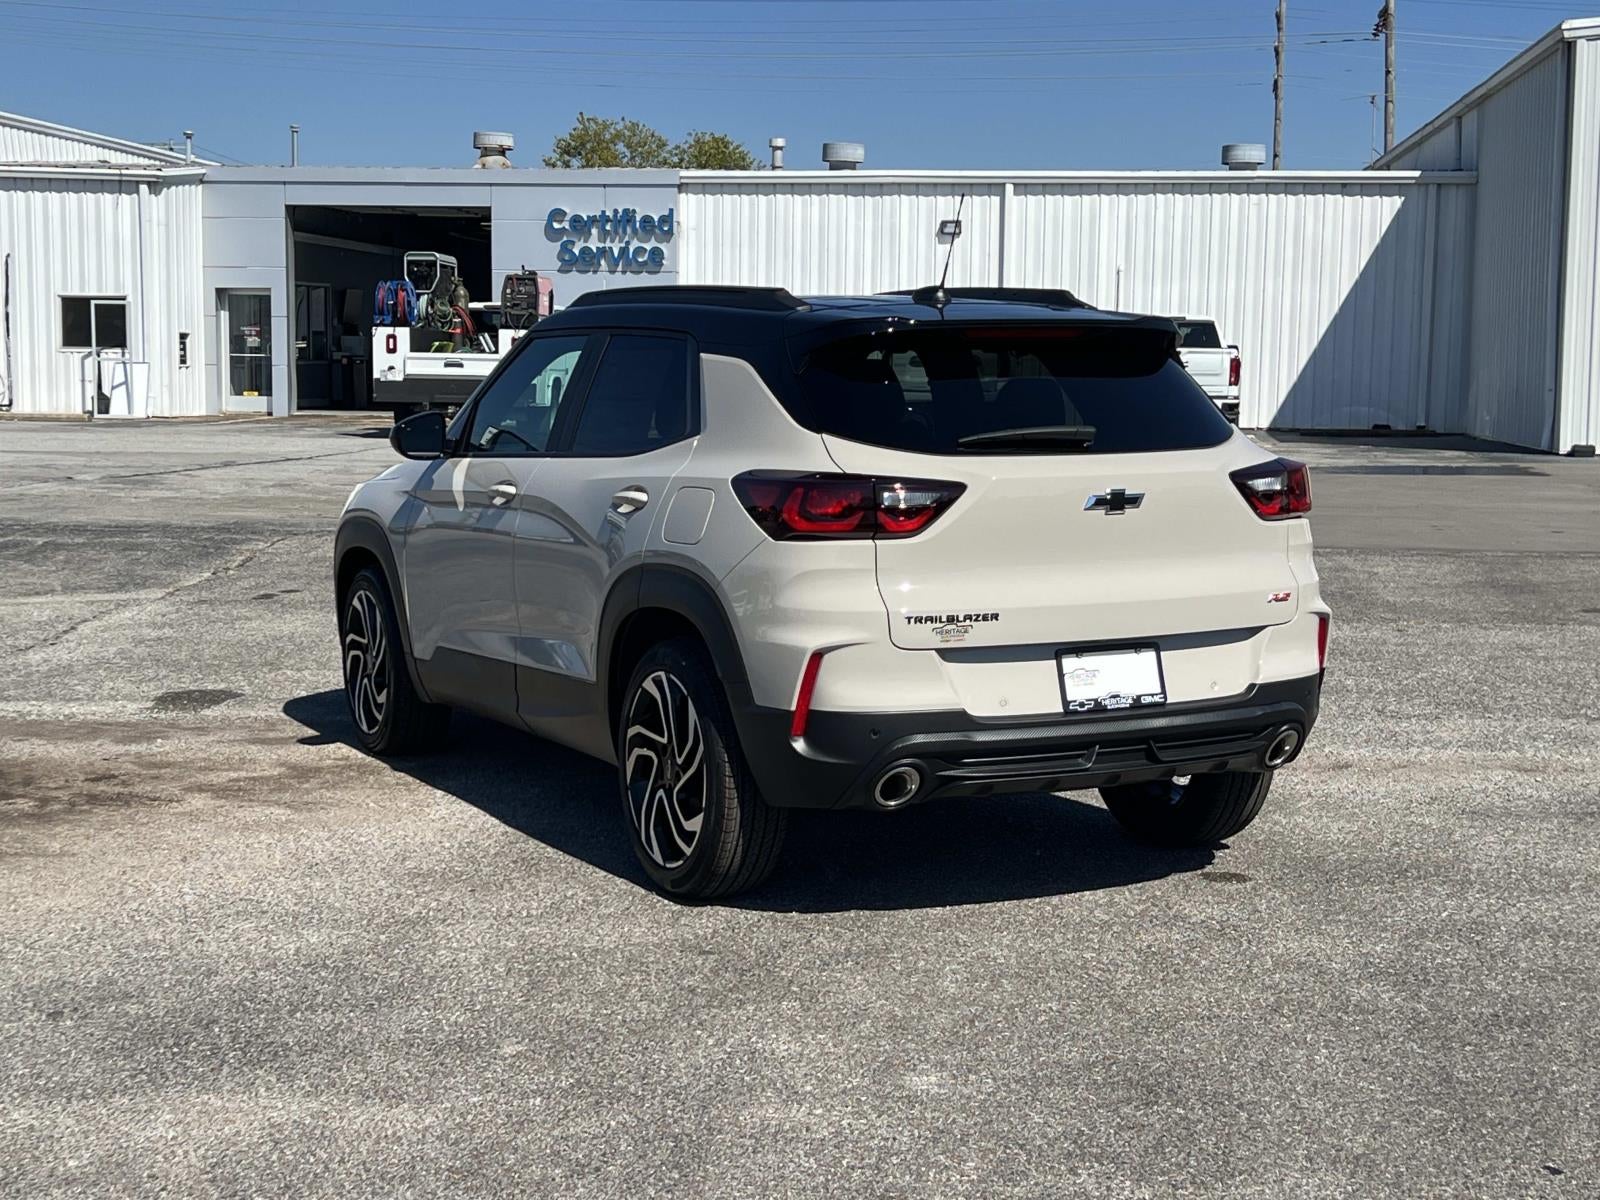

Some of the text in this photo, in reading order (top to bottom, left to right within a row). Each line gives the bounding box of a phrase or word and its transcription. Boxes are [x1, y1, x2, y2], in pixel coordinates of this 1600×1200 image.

[546, 207, 674, 237] Certified
[559, 239, 665, 267] Service
[905, 612, 1000, 625] TRAILBLAZER
[935, 627, 970, 636] HERITAGE
[1101, 696, 1134, 706] HERITAGE
[1140, 694, 1165, 703] GMC
